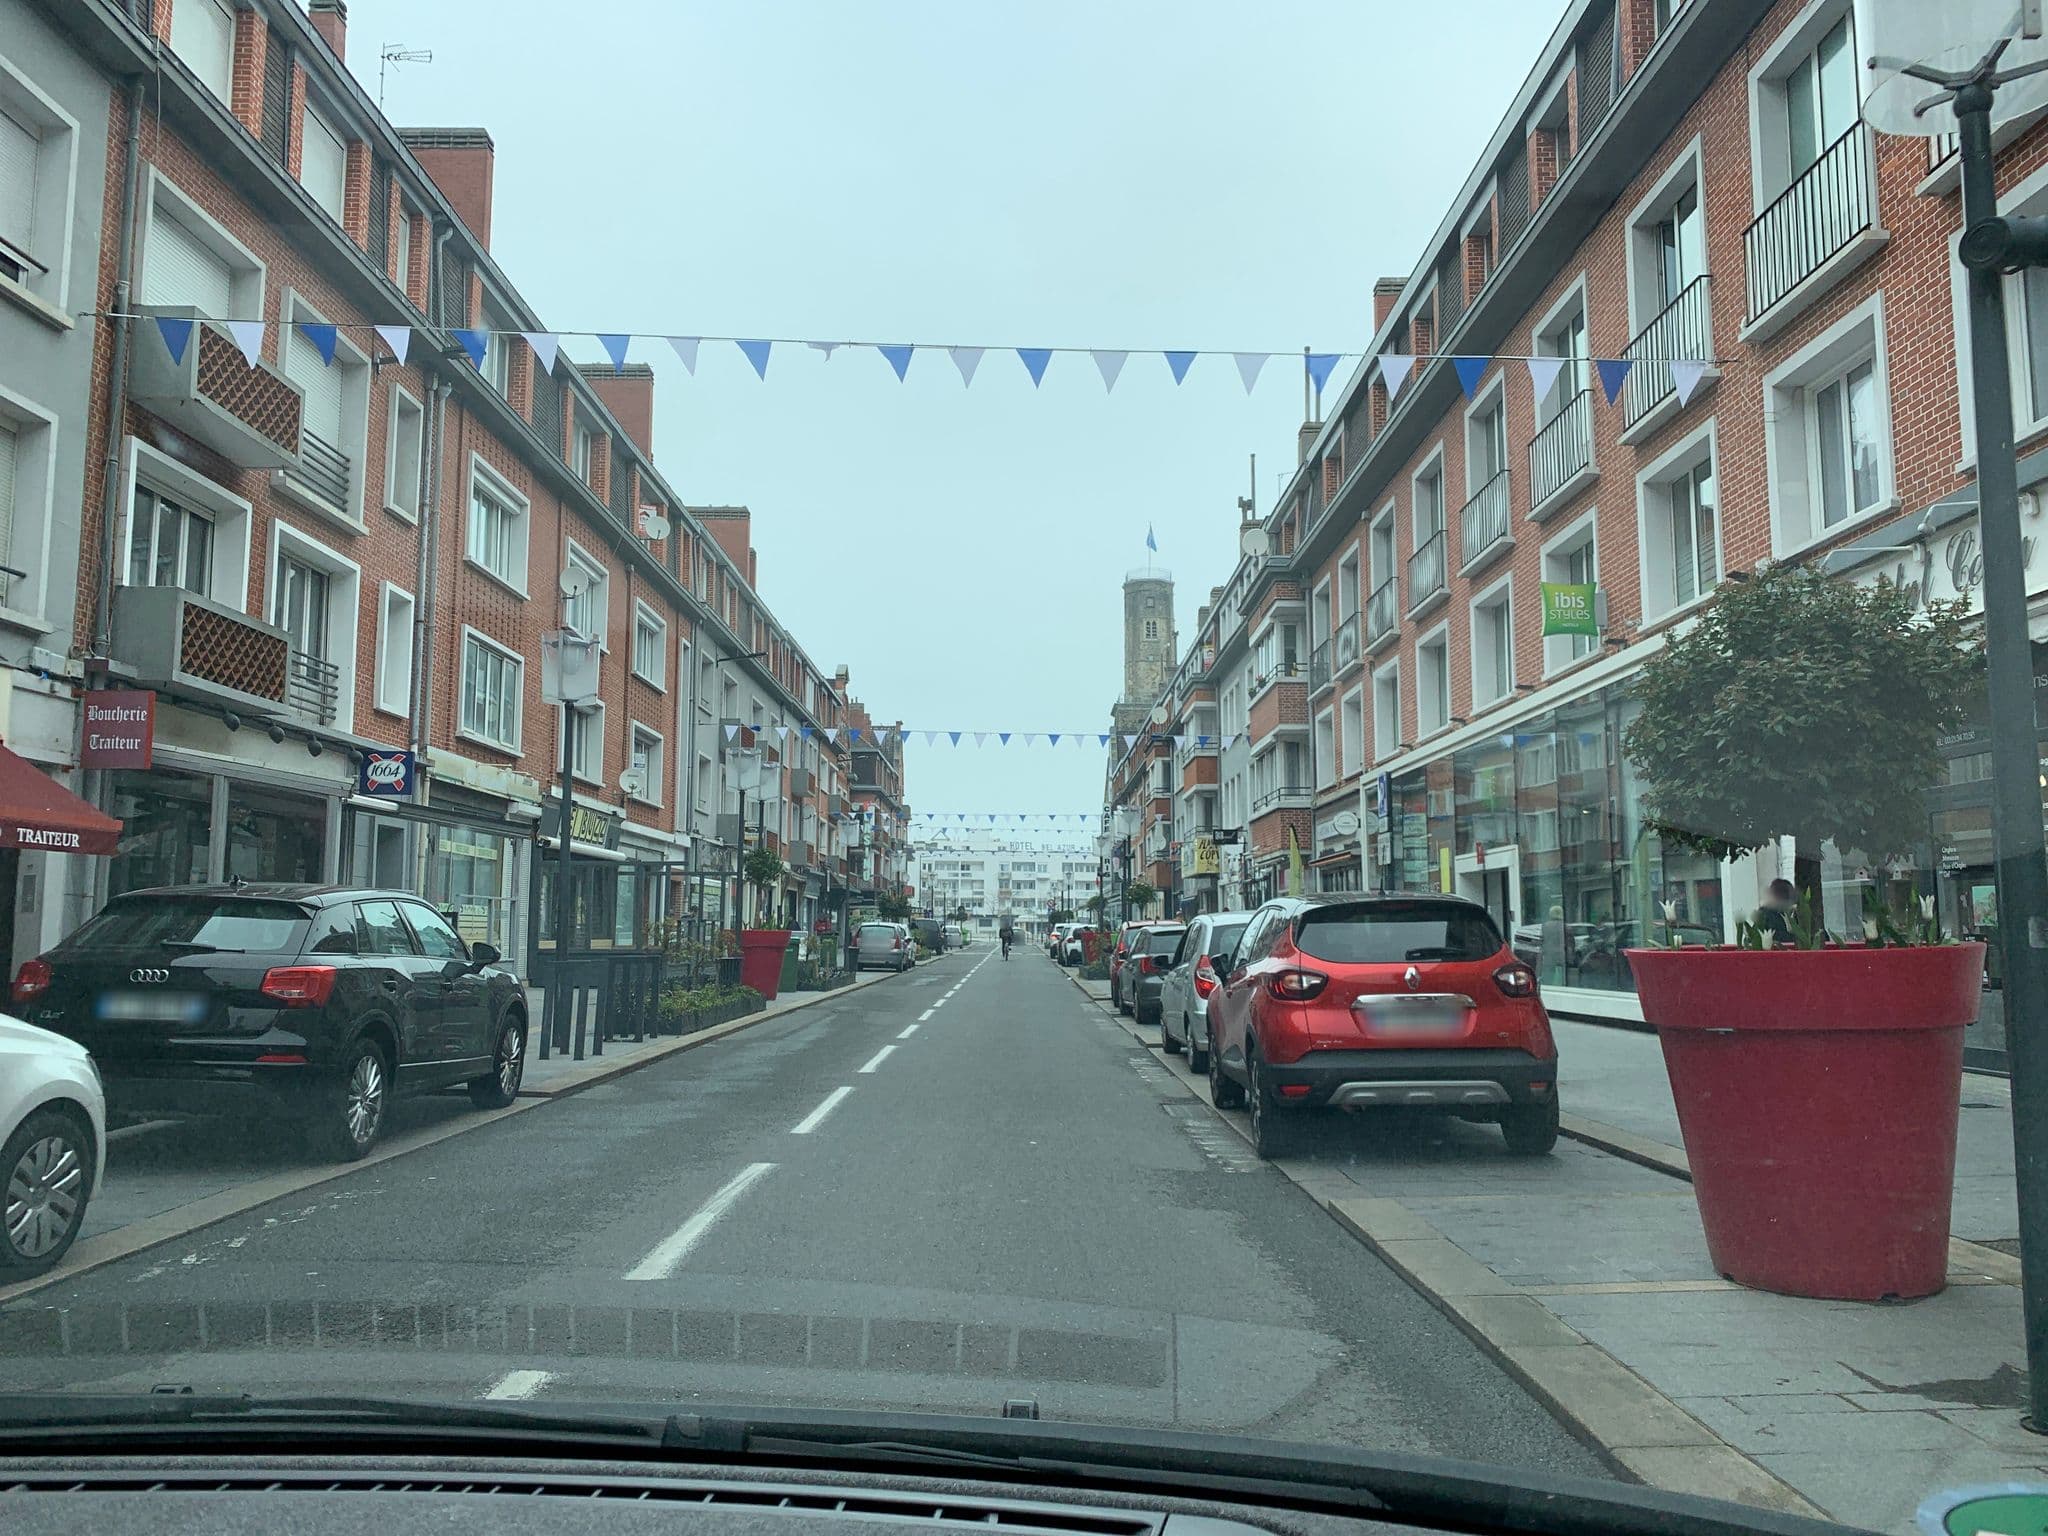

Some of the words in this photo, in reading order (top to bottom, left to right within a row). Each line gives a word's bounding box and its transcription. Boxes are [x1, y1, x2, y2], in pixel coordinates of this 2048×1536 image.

[1555, 592, 1585, 608] ibis
[87, 705, 148, 723] Boucherie
[89, 734, 141, 750] Traiteur
[370, 762, 400, 777] 1664
[16, 828, 80, 847] TRAITEUR
[1198, 839, 1218, 850] PLA
